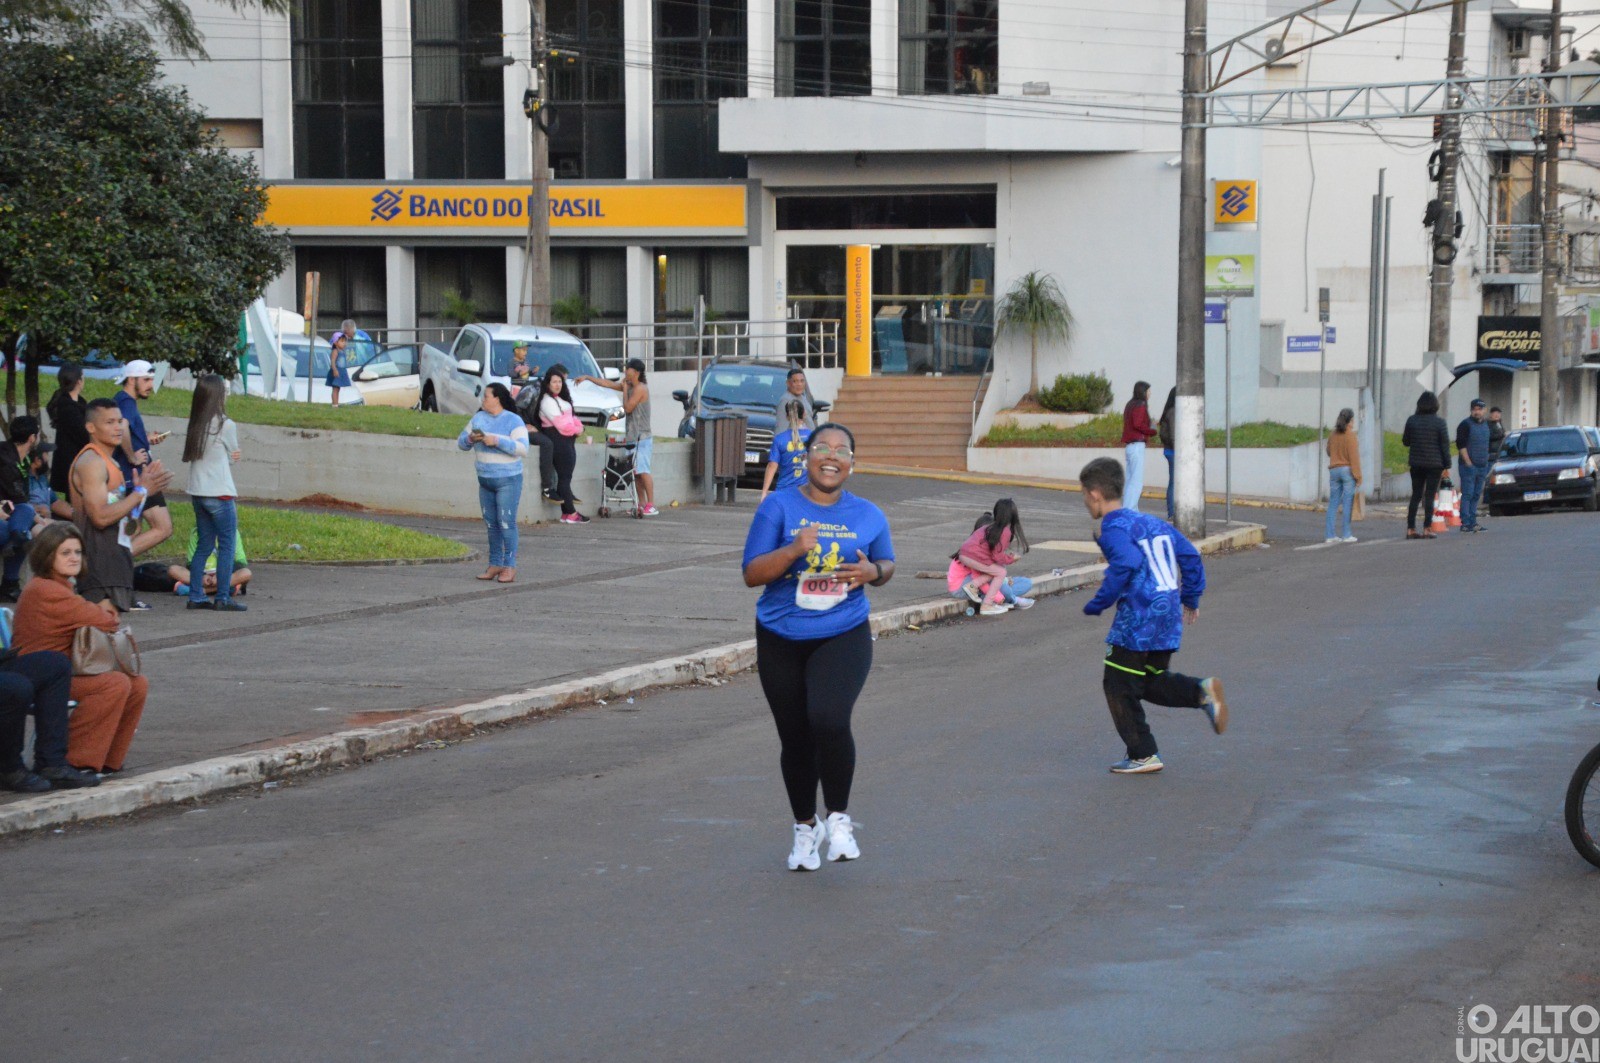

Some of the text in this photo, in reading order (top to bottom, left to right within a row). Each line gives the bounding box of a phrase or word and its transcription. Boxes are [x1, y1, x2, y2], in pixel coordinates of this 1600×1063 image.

[409, 195, 605, 217] BANCO DO RASIL
[854, 256, 862, 343] Autoatendimento
[1137, 535, 1178, 591] 10
[808, 580, 839, 593] 002
